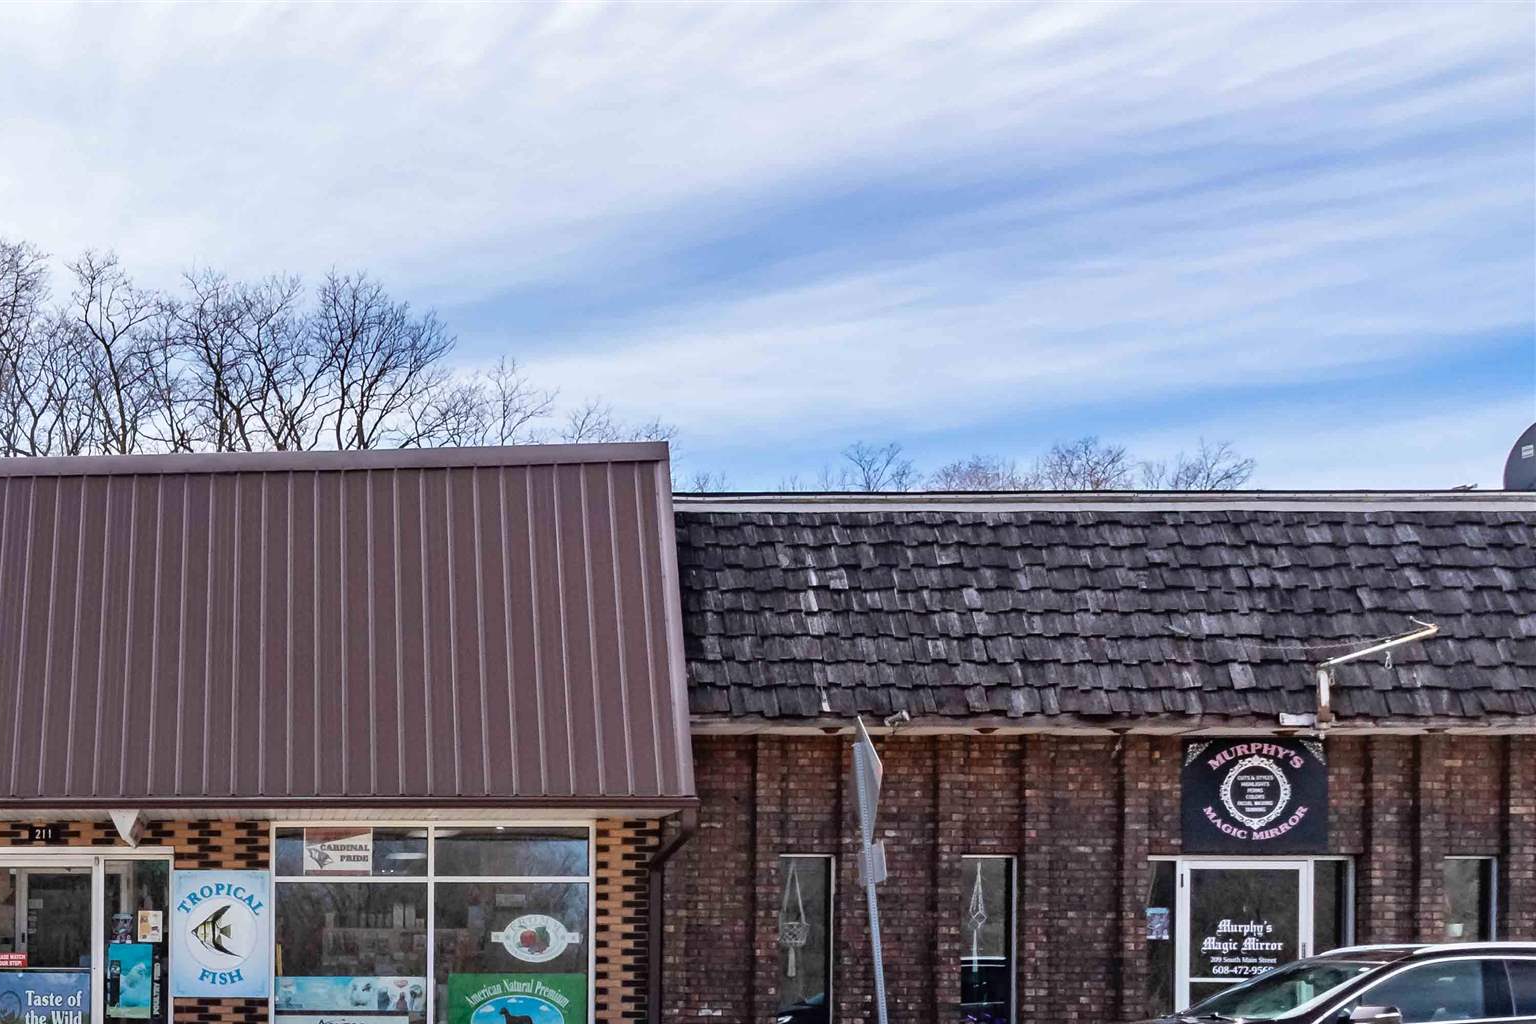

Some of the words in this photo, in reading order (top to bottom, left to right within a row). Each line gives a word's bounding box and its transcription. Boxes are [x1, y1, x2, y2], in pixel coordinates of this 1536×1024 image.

[1207, 742, 1305, 770] MURPHY'S
[1203, 805, 1247, 840] MAGIC
[1252, 805, 1309, 840] MIRROR
[35, 828, 52, 839] 211
[320, 843, 370, 852] CARDINAL
[339, 854, 369, 863] PRIDE
[176, 883, 264, 916] TROPICAL
[1216, 919, 1273, 937] Murphy's
[1201, 936, 1238, 954] Magic
[1241, 936, 1284, 954] Mirror
[198, 967, 244, 985] FISH
[25, 990, 63, 1007] Taste
[67, 990, 82, 1007] of
[465, 983, 502, 1007] American
[503, 979, 534, 993] Natural
[534, 980, 570, 1009] Premium
